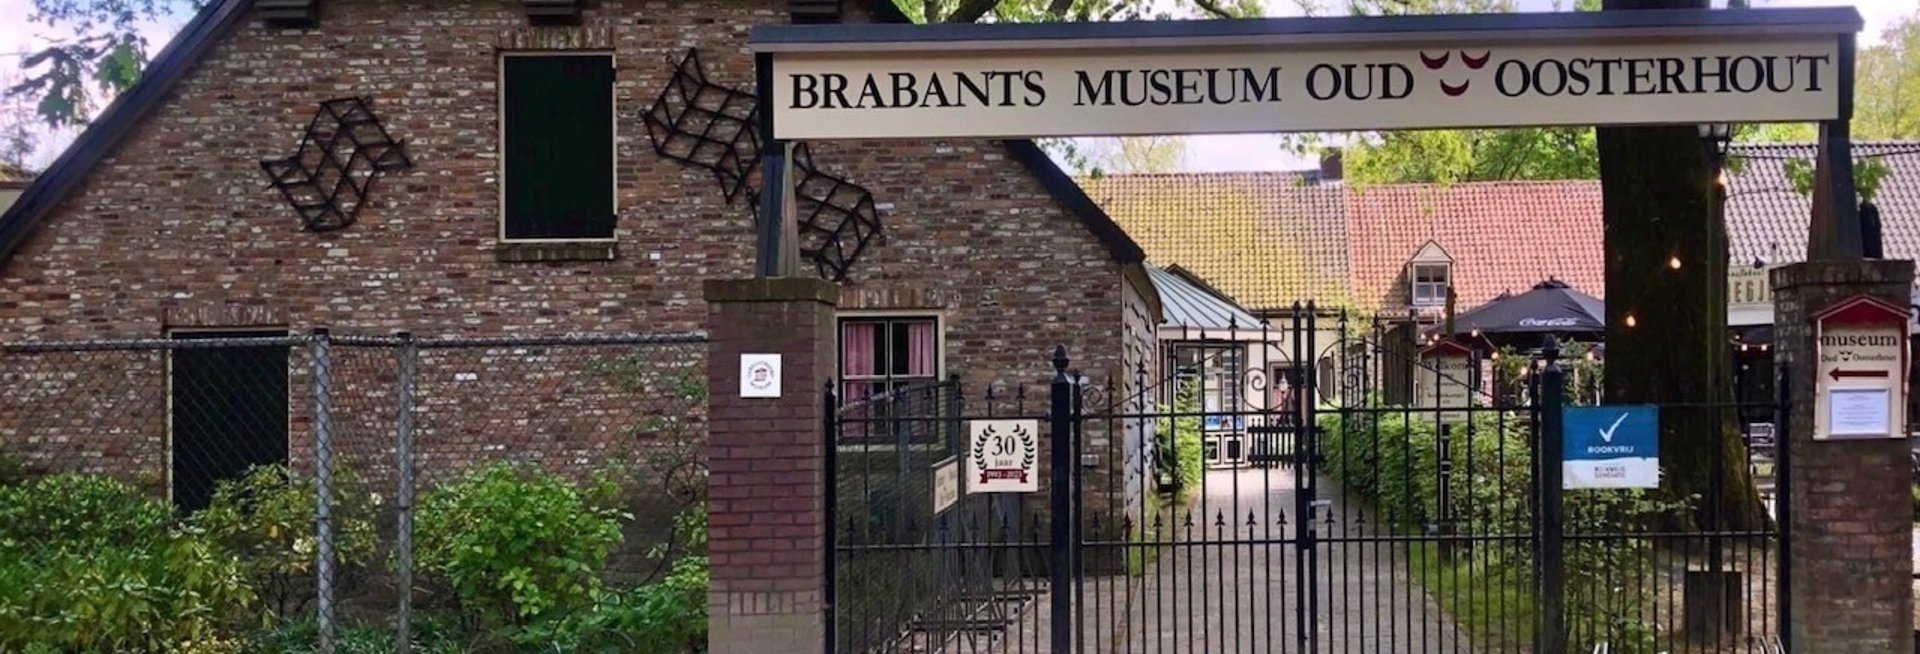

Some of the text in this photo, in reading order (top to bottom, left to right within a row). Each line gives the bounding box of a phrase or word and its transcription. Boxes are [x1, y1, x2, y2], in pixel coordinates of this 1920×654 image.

[789, 55, 1829, 109] BRABANTS MUSEUM OUD OOSTERHOUT
[1821, 334, 1897, 347] museum
[1821, 354, 1838, 362] Oud
[991, 435, 1016, 456] 30
[1587, 446, 1635, 454] ROOKVRIJ
[994, 457, 1013, 467] jaar
